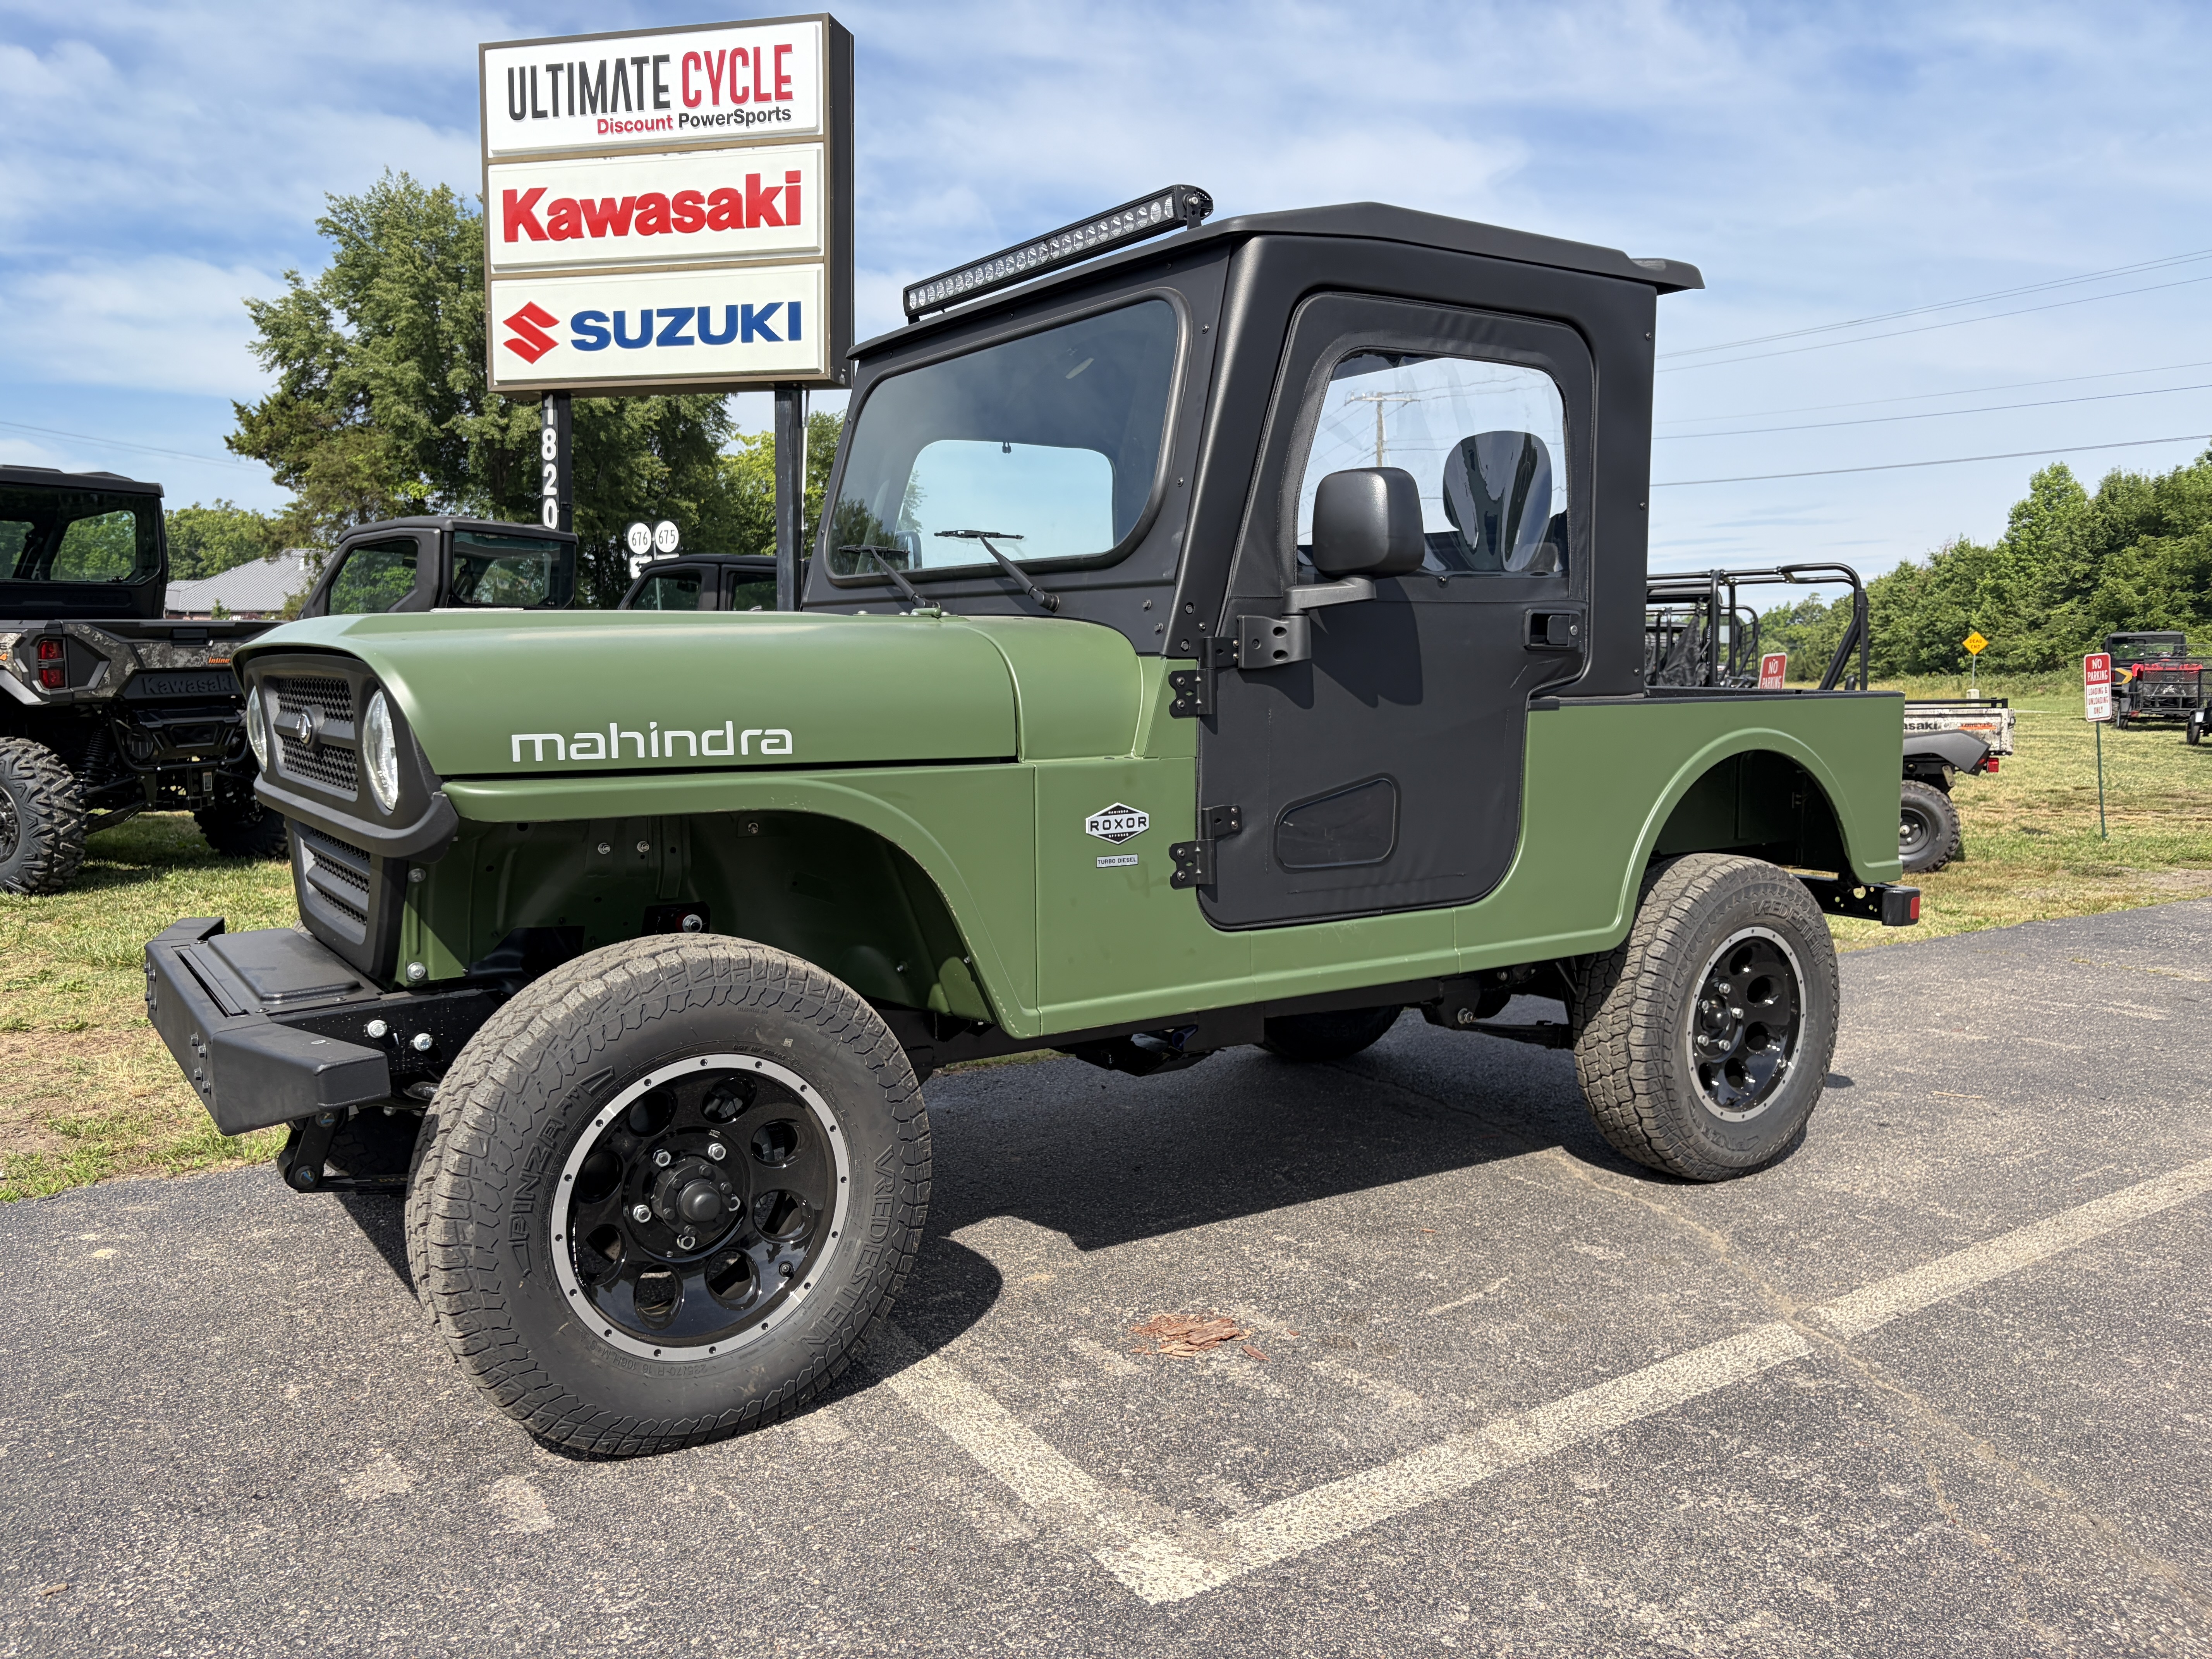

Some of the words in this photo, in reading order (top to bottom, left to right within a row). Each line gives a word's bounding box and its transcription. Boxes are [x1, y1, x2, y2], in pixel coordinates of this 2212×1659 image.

[508, 54, 671, 120] ULTIMATE
[682, 44, 793, 109] CYCLE
[597, 115, 673, 134] Discount
[678, 106, 792, 129] PowerSports
[502, 170, 801, 242] Kawasaki
[570, 301, 801, 351] SUZUKI
[632, 533, 648, 547] 676
[658, 529, 675, 542] 675
[1768, 660, 1778, 675] NO
[2092, 658, 2102, 669] NO
[2087, 670, 2108, 682] PARKING
[2088, 687, 2103, 696] LOADING
[2088, 696, 2108, 705] UNLOADING
[2094, 706, 2103, 714] ONLY
[512, 721, 792, 762] mahindra
[1090, 816, 1147, 832] ROXOR
[798, 1144, 896, 1352] VREDESTEIN
